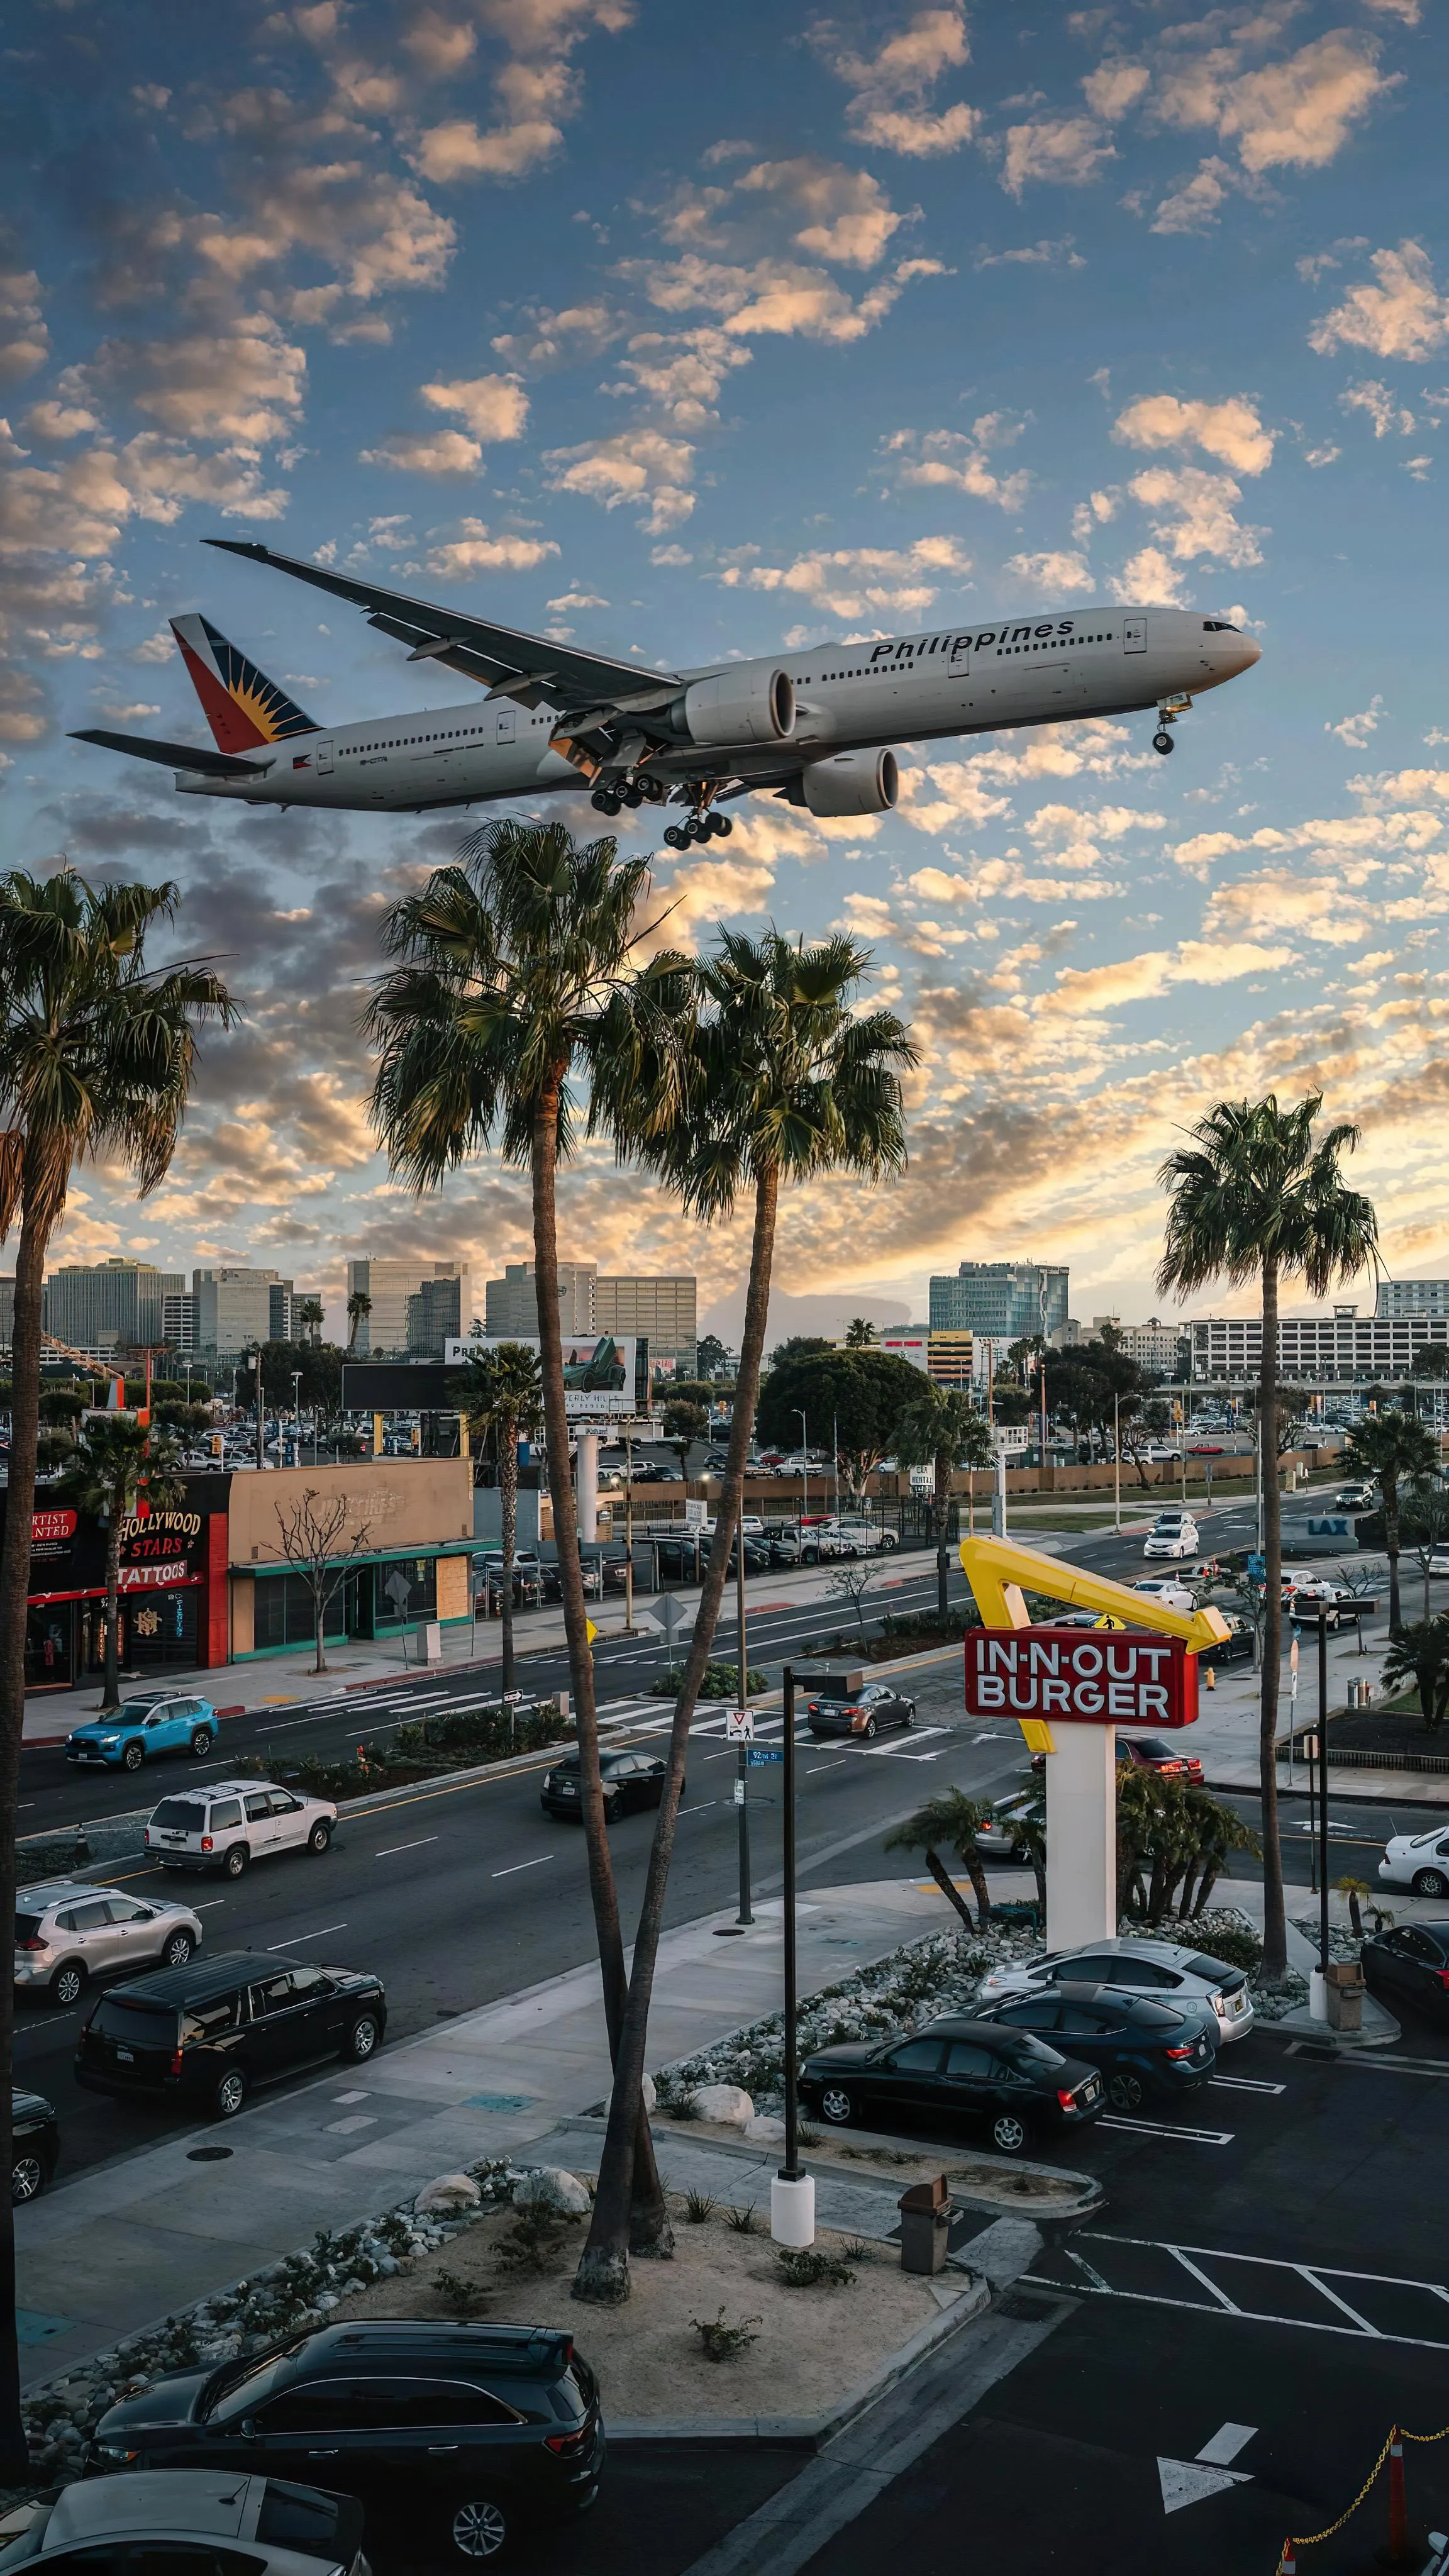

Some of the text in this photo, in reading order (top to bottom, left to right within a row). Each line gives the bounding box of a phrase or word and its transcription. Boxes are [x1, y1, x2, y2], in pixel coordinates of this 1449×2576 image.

[871, 620, 1075, 662] Philippines
[32, 1513, 68, 1526] RTIST
[118, 1511, 201, 1541] HOLLYWOOD
[1309, 1519, 1348, 1535] LAX
[31, 1525, 69, 1538] NTED
[130, 1537, 183, 1557] STARS
[118, 1562, 185, 1584] TATTOOS
[977, 1640, 1172, 1681] IN-N-OUT
[977, 1675, 1169, 1718] BURGER
